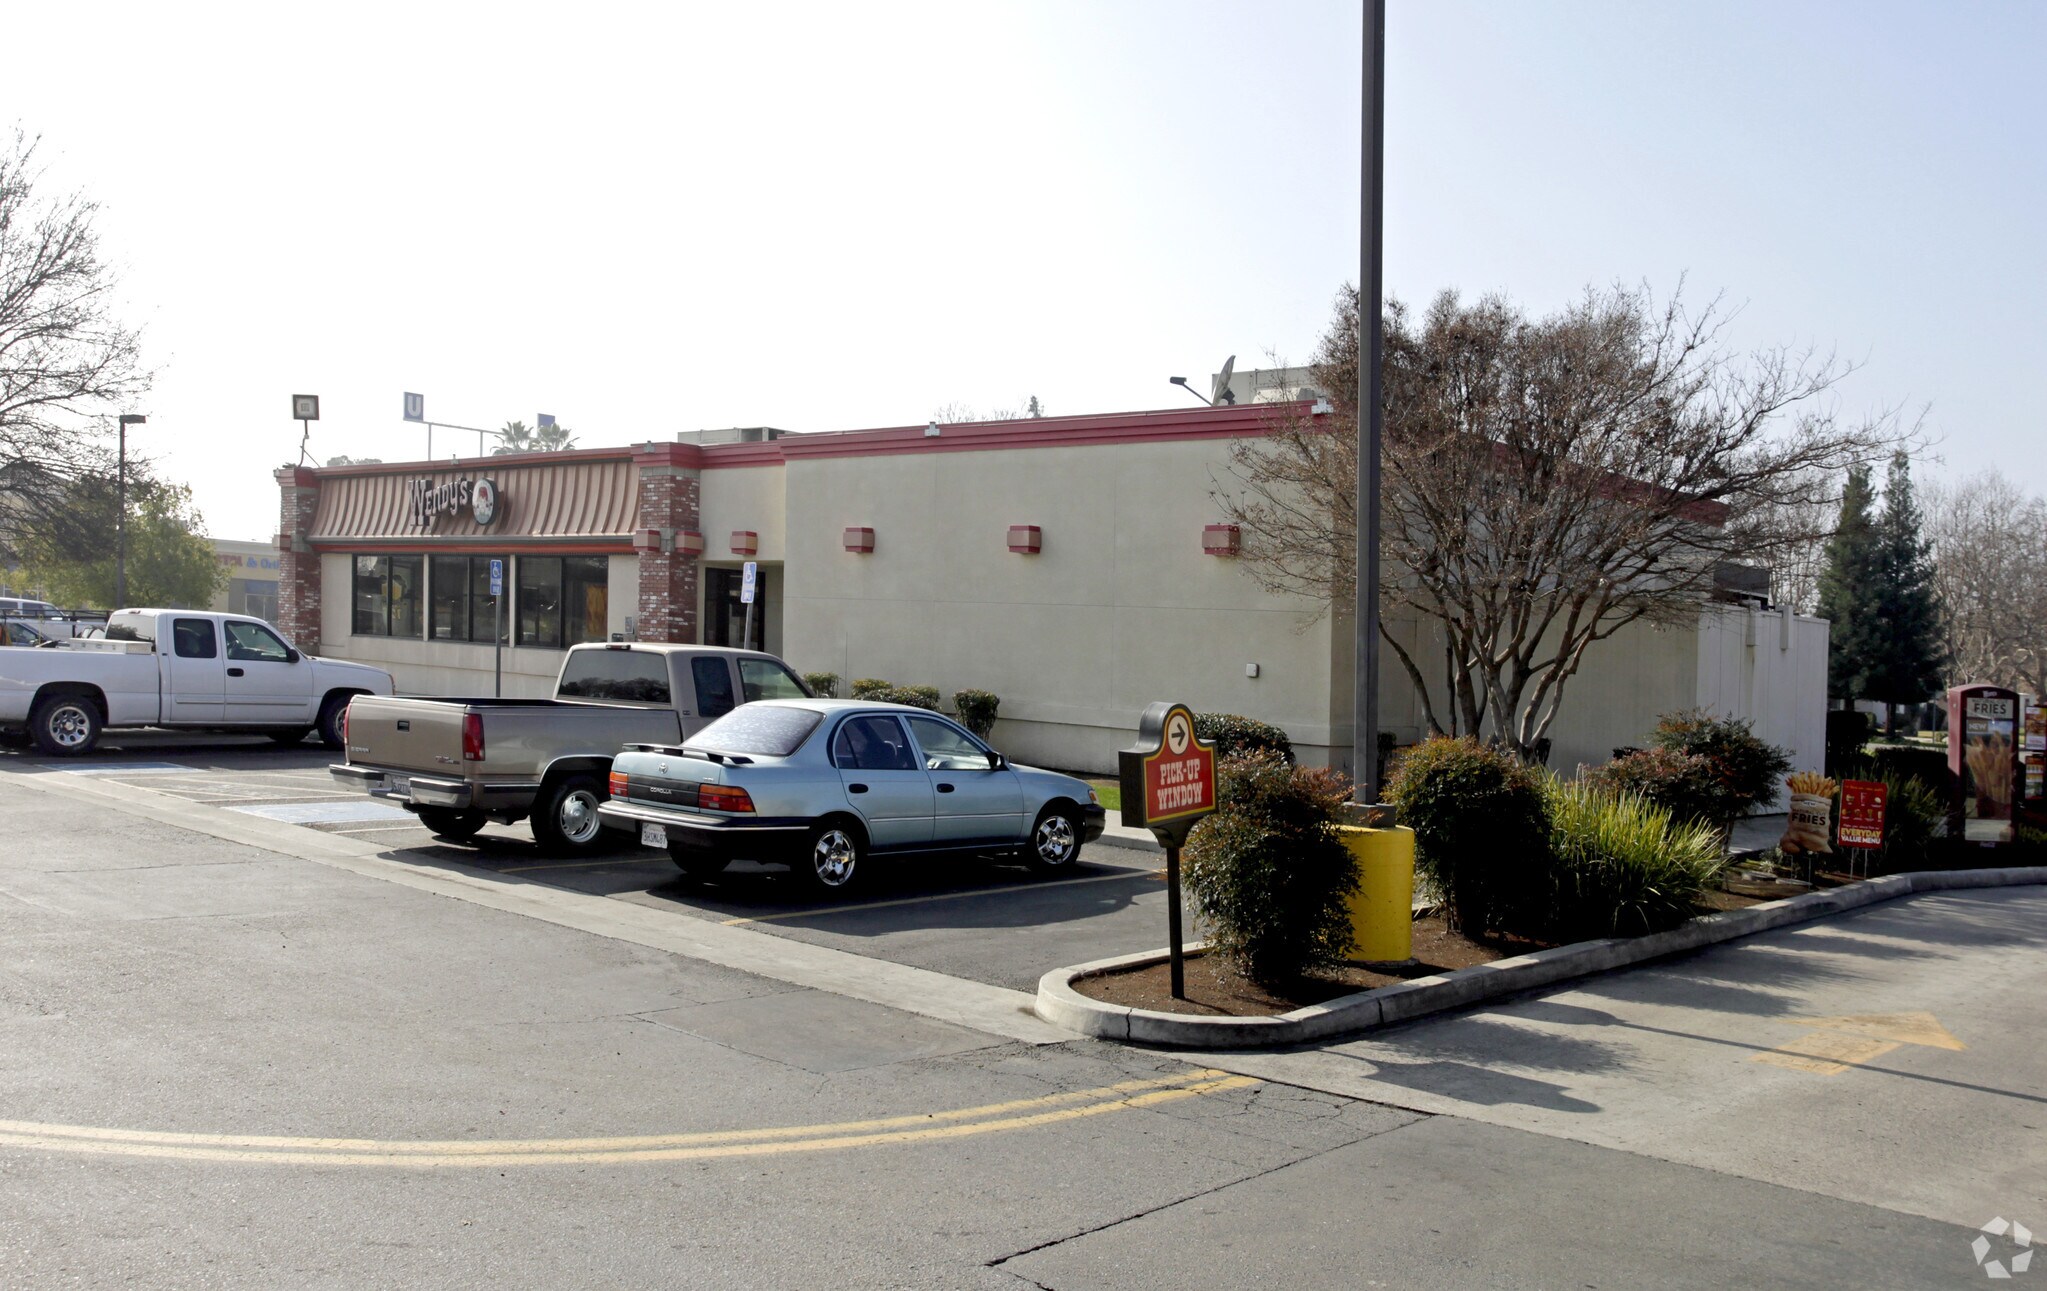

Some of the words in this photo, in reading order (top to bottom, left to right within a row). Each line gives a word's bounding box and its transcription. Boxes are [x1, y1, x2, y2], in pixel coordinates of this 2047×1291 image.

[407, 395, 421, 417] U
[1974, 703, 2006, 715] FRIES
[1160, 758, 1200, 785] PICK-UP
[650, 786, 672, 795] COROLLA
[1157, 782, 1203, 810] WINDOW
[1792, 812, 1826, 826] FRIES
[1841, 828, 1882, 838] EVERYDAY
